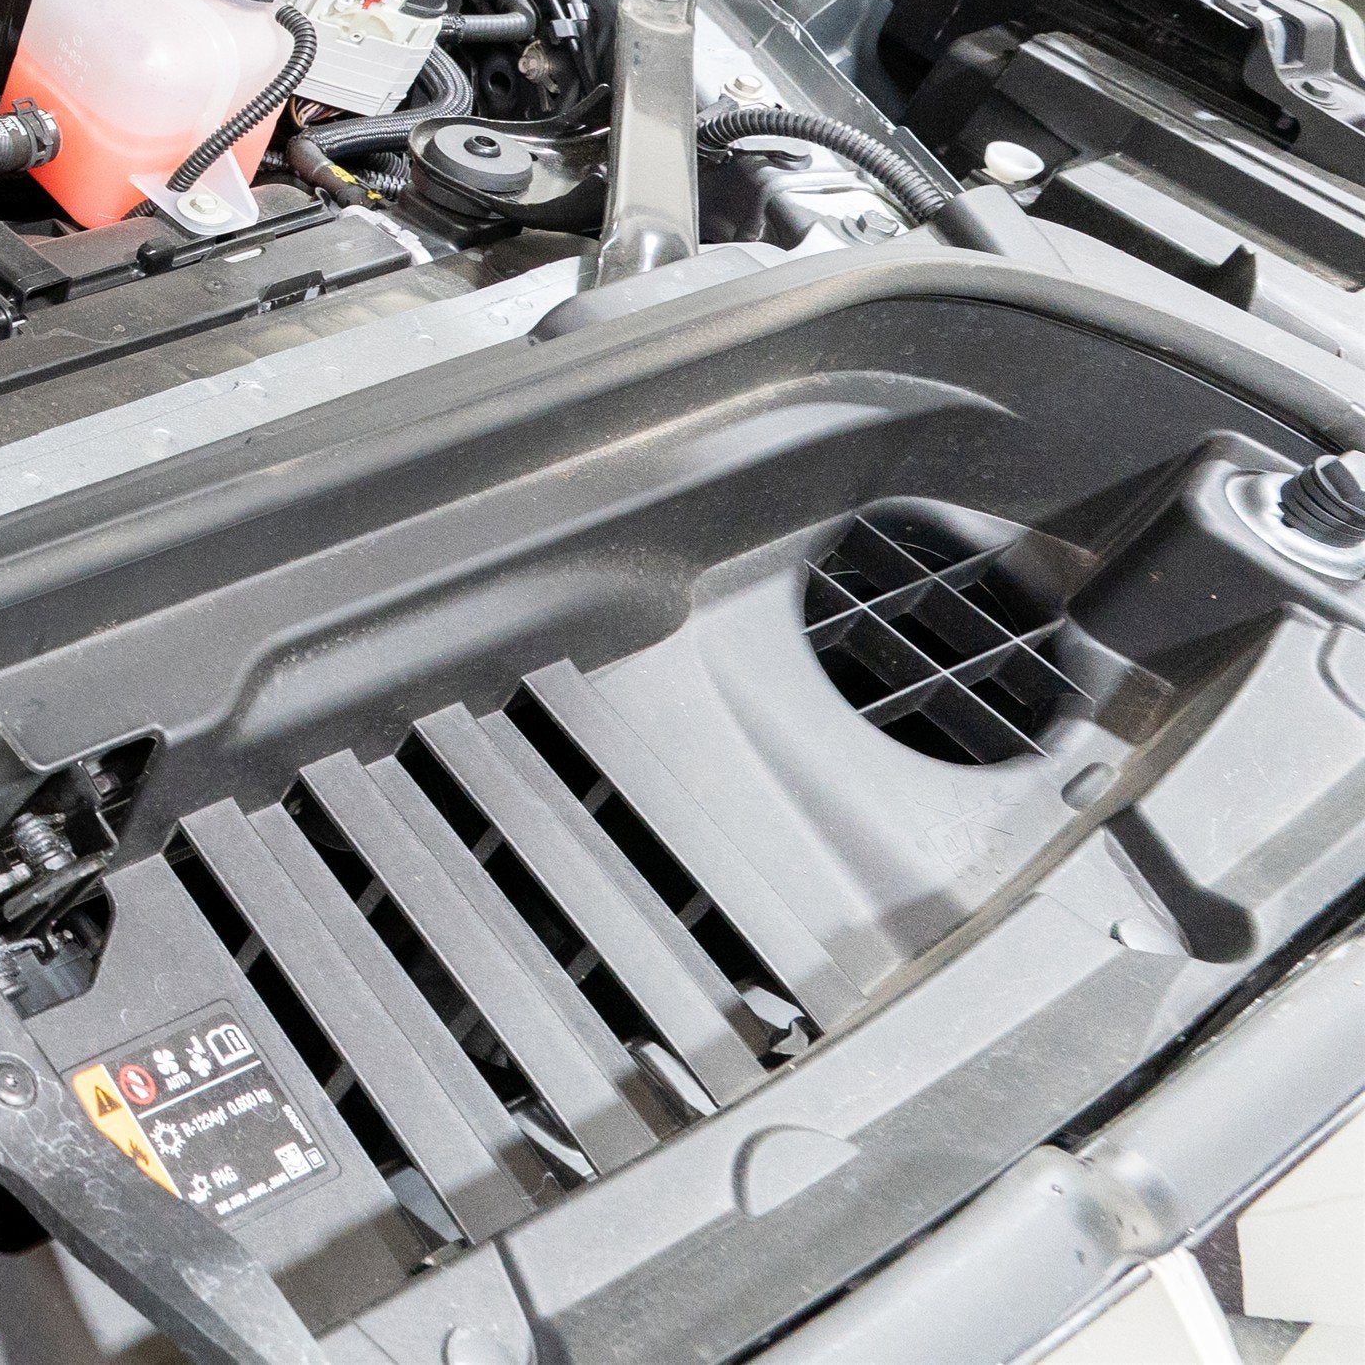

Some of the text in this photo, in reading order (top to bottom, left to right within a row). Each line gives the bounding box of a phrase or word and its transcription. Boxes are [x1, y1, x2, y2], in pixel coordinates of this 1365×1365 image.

[166, 1072, 191, 1091] AUTO
[180, 1106, 226, 1138] R-1234yf
[253, 1088, 273, 1104] kg
[211, 1165, 238, 1189] PAG
